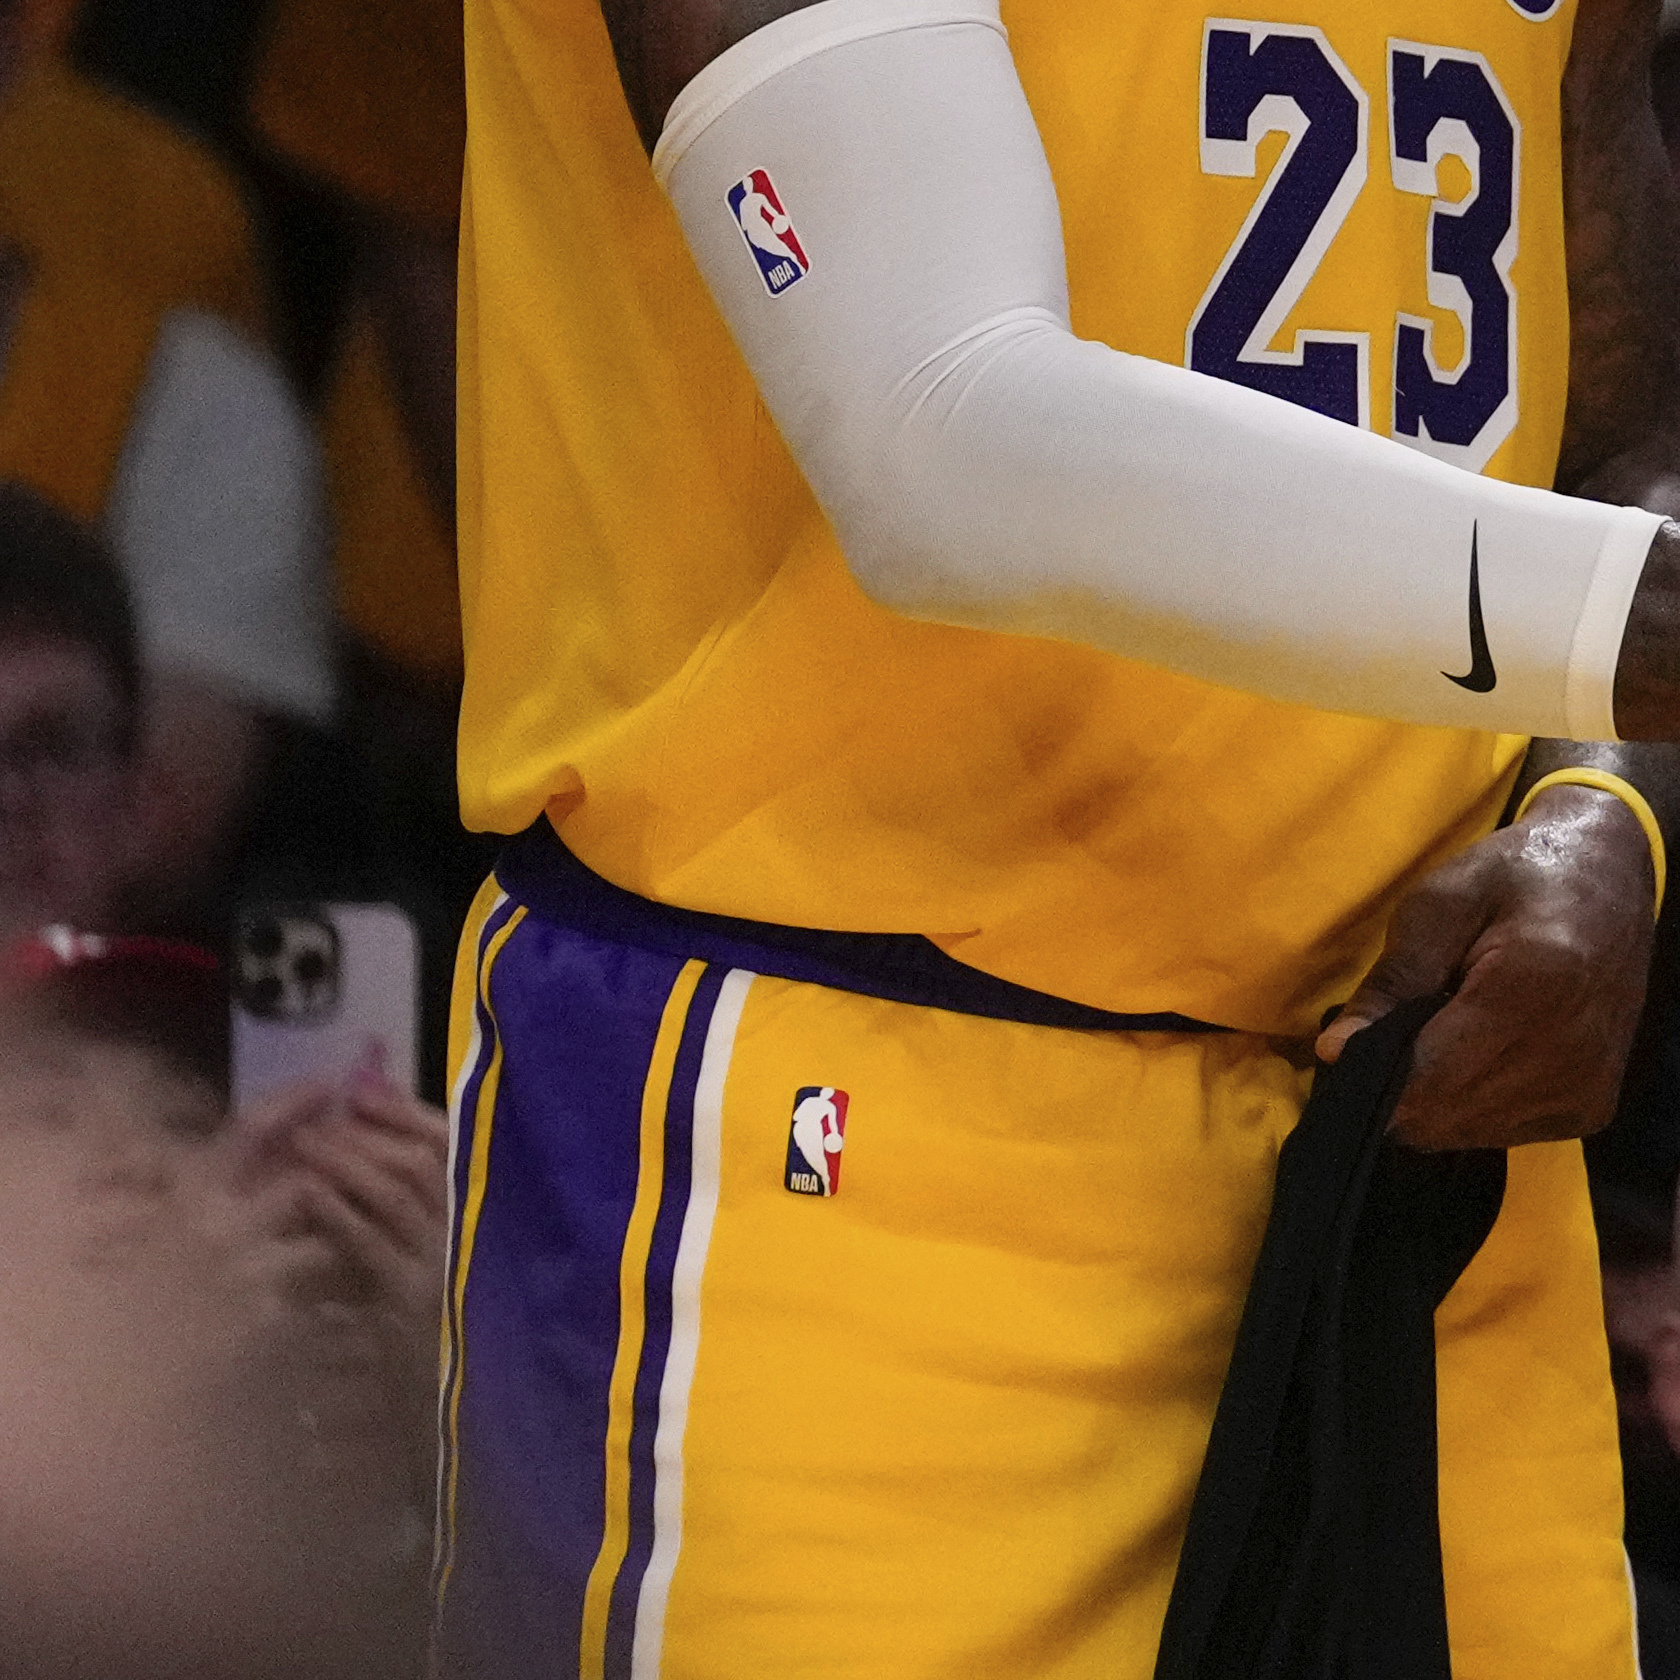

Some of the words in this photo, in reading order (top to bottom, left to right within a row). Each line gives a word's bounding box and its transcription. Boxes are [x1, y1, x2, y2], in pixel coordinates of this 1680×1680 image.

[1186, 17, 1523, 476] 23
[767, 261, 795, 290] NBA
[789, 1172, 819, 1193] NBA
